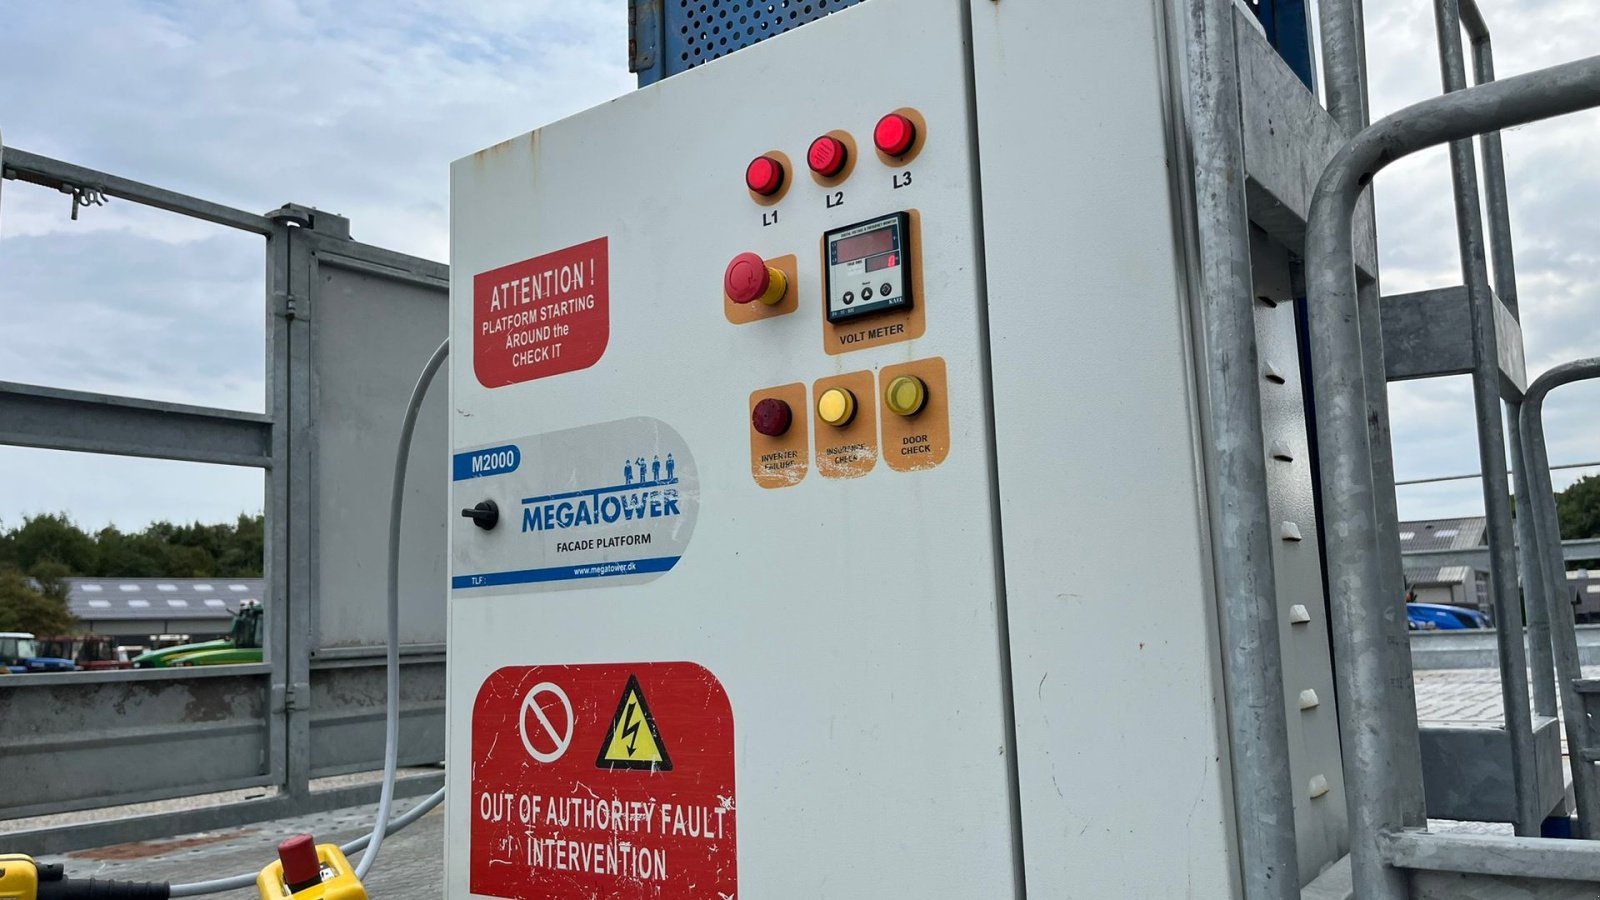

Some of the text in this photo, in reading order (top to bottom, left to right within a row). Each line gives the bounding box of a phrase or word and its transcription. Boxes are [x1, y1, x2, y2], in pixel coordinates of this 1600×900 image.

[893, 171, 913, 189] L3
[826, 191, 844, 209] L2
[762, 210, 779, 227] L1
[490, 258, 595, 312] ATTENTION !
[482, 294, 595, 335] PLATFORM STARTING
[506, 324, 569, 349] AROUND the
[840, 323, 904, 345] VOLT METER
[512, 343, 562, 367] CHECK IT
[901, 445, 931, 455] CHECK
[903, 435, 928, 445] DOOR
[472, 450, 514, 473] M2000
[761, 450, 798, 463] INVERTER
[834, 454, 858, 464] CHECK
[522, 489, 681, 533] MEGATOWER
[557, 533, 652, 553] FACADE PLATFORM
[573, 563, 637, 576] www.megatower.dk
[472, 577, 483, 585] TLF
[480, 792, 727, 839] OUT OF AUTHORITY FAULT
[527, 836, 667, 881] INTERVENTION
